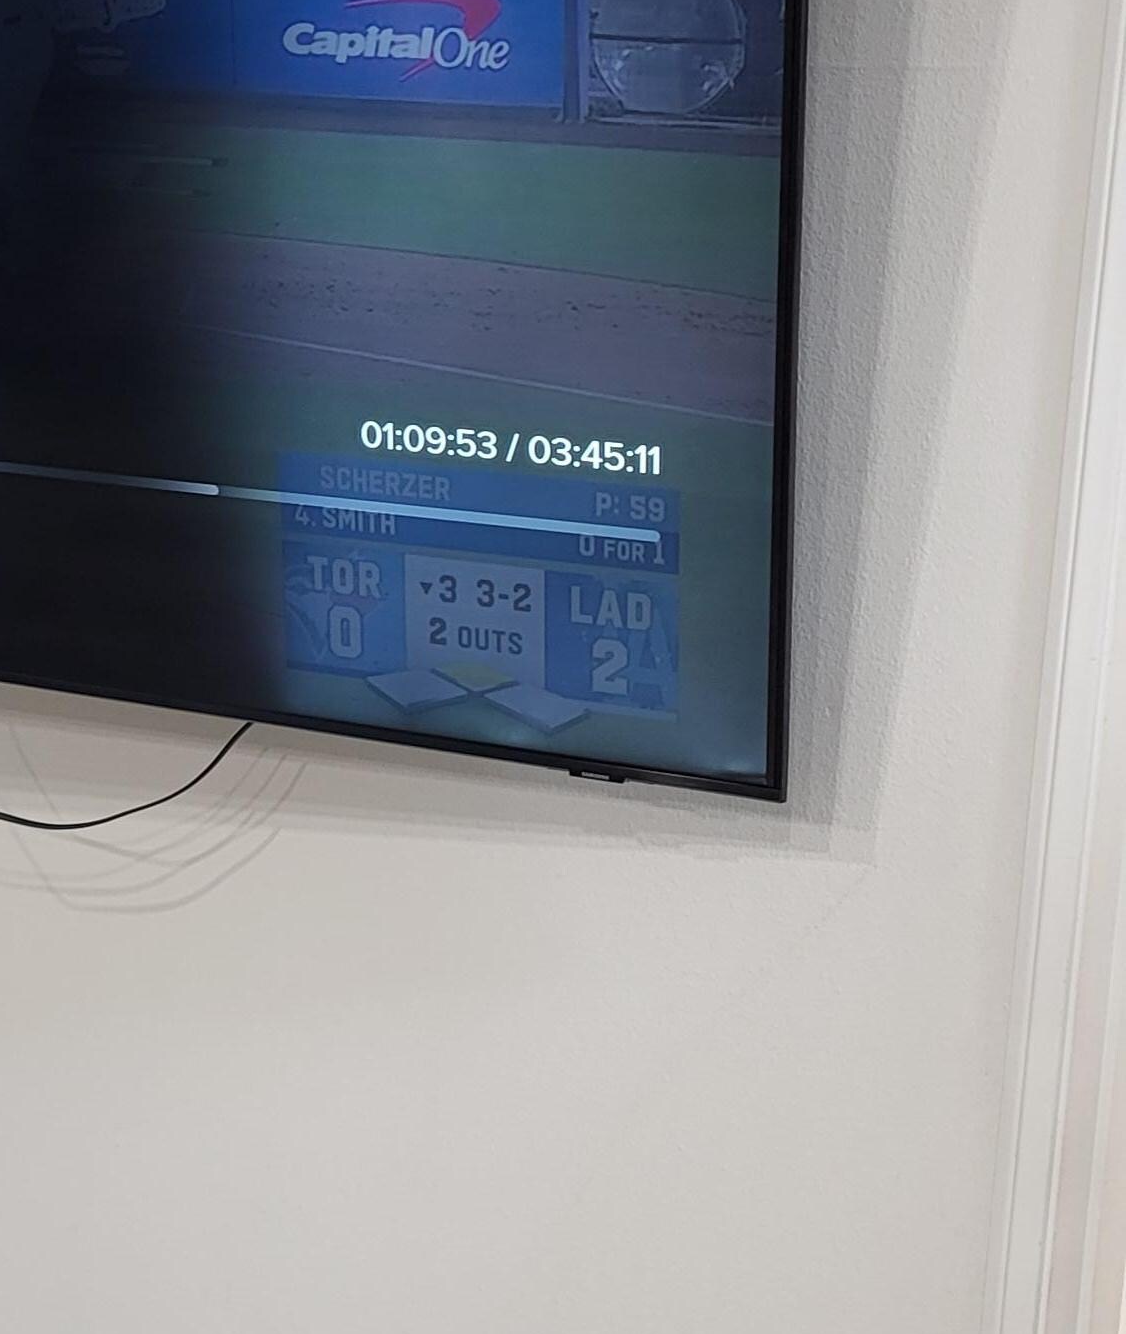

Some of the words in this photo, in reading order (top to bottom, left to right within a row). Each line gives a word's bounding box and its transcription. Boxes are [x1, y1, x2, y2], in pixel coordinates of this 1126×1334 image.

[360, 420, 498, 460] 01:09:53
[527, 434, 662, 476] 03:45:11
[320, 465, 451, 502] SCHERZER
[322, 508, 397, 536] SMITH
[595, 491, 620, 517] P:
[629, 494, 667, 524] 59
[603, 538, 645, 565] FOR
[307, 555, 381, 598] TOR
[476, 578, 532, 613] 3-2
[571, 585, 652, 631] LAD
[330, 605, 363, 659] 0
[429, 616, 448, 646] 2
[457, 624, 524, 656] OUTS
[592, 637, 628, 697] 2
